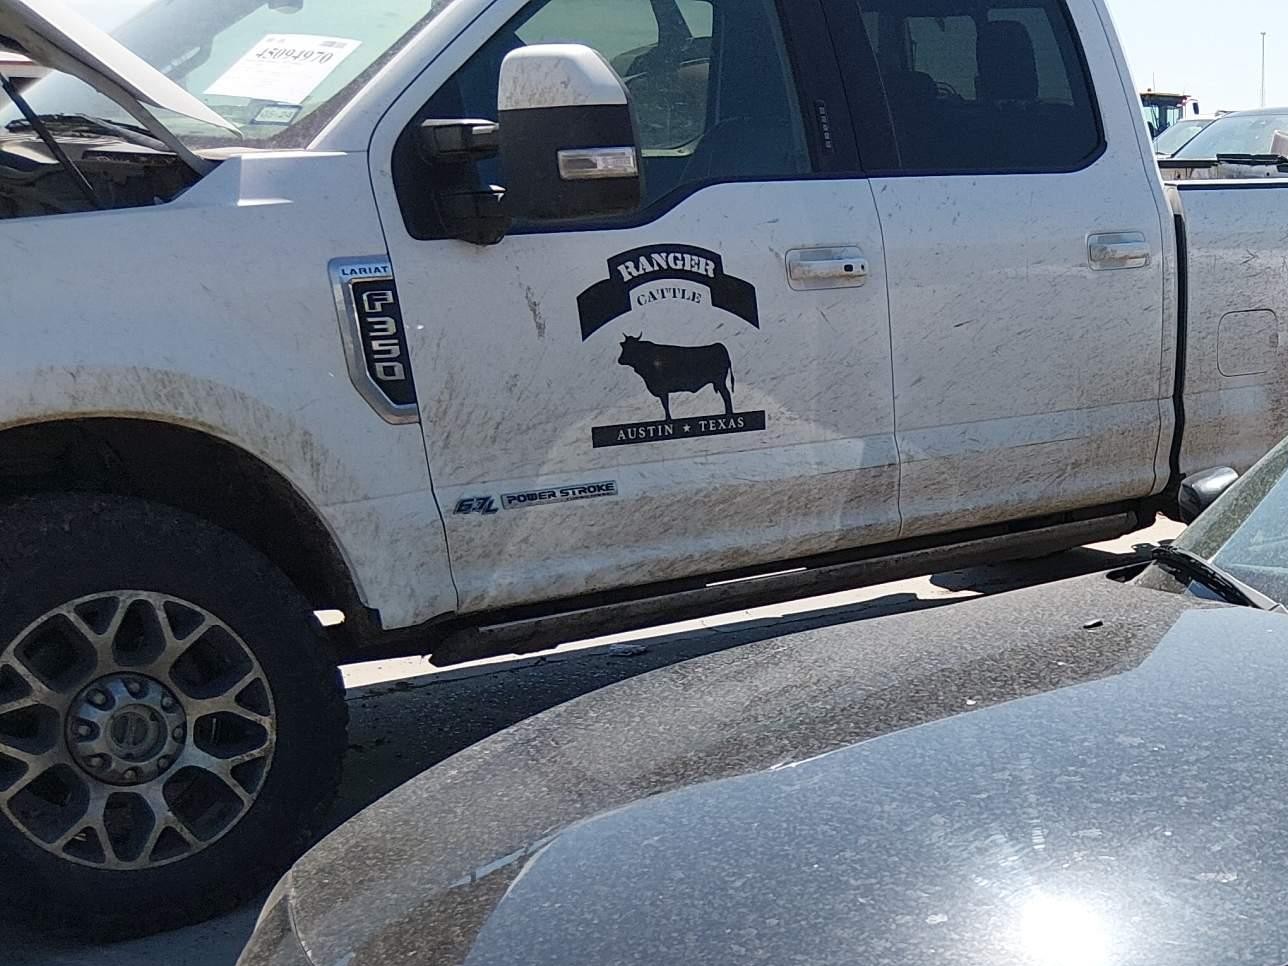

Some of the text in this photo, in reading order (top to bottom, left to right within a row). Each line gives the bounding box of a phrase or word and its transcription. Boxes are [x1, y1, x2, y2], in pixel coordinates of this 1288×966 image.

[257, 48, 334, 64] 45094970
[341, 265, 389, 277] LARIAT
[617, 252, 716, 282] RANGER
[636, 287, 702, 306] CATTLE
[362, 290, 406, 381] F350
[617, 416, 745, 441] AUSTIN TEXAS
[506, 492, 557, 504] POWER
[559, 482, 615, 497] STROKE
